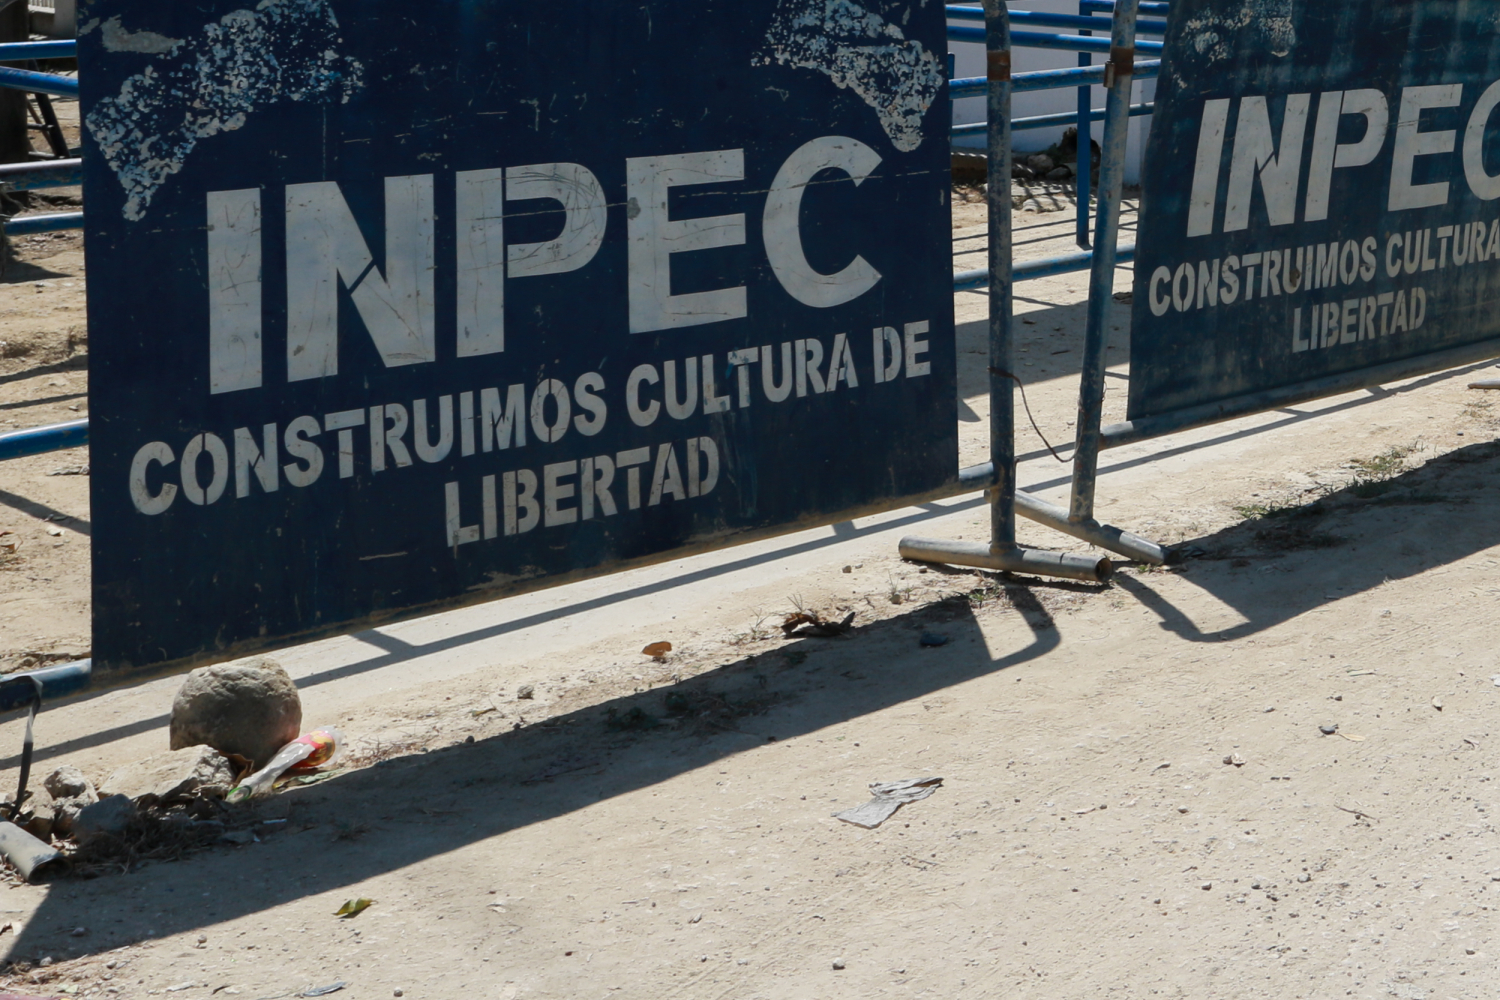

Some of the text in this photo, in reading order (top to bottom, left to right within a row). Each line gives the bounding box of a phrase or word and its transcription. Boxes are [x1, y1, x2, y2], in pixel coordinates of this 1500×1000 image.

[206, 135, 883, 395] INPEC
[1149, 237, 1377, 317] CONSTRUIMOS
[1385, 218, 1500, 278] CULTURA
[1292, 287, 1426, 354] LIBERTAD
[128, 320, 931, 516] CONSTRUIMOS CULTURA DE
[445, 436, 720, 548] LIBERTAD
